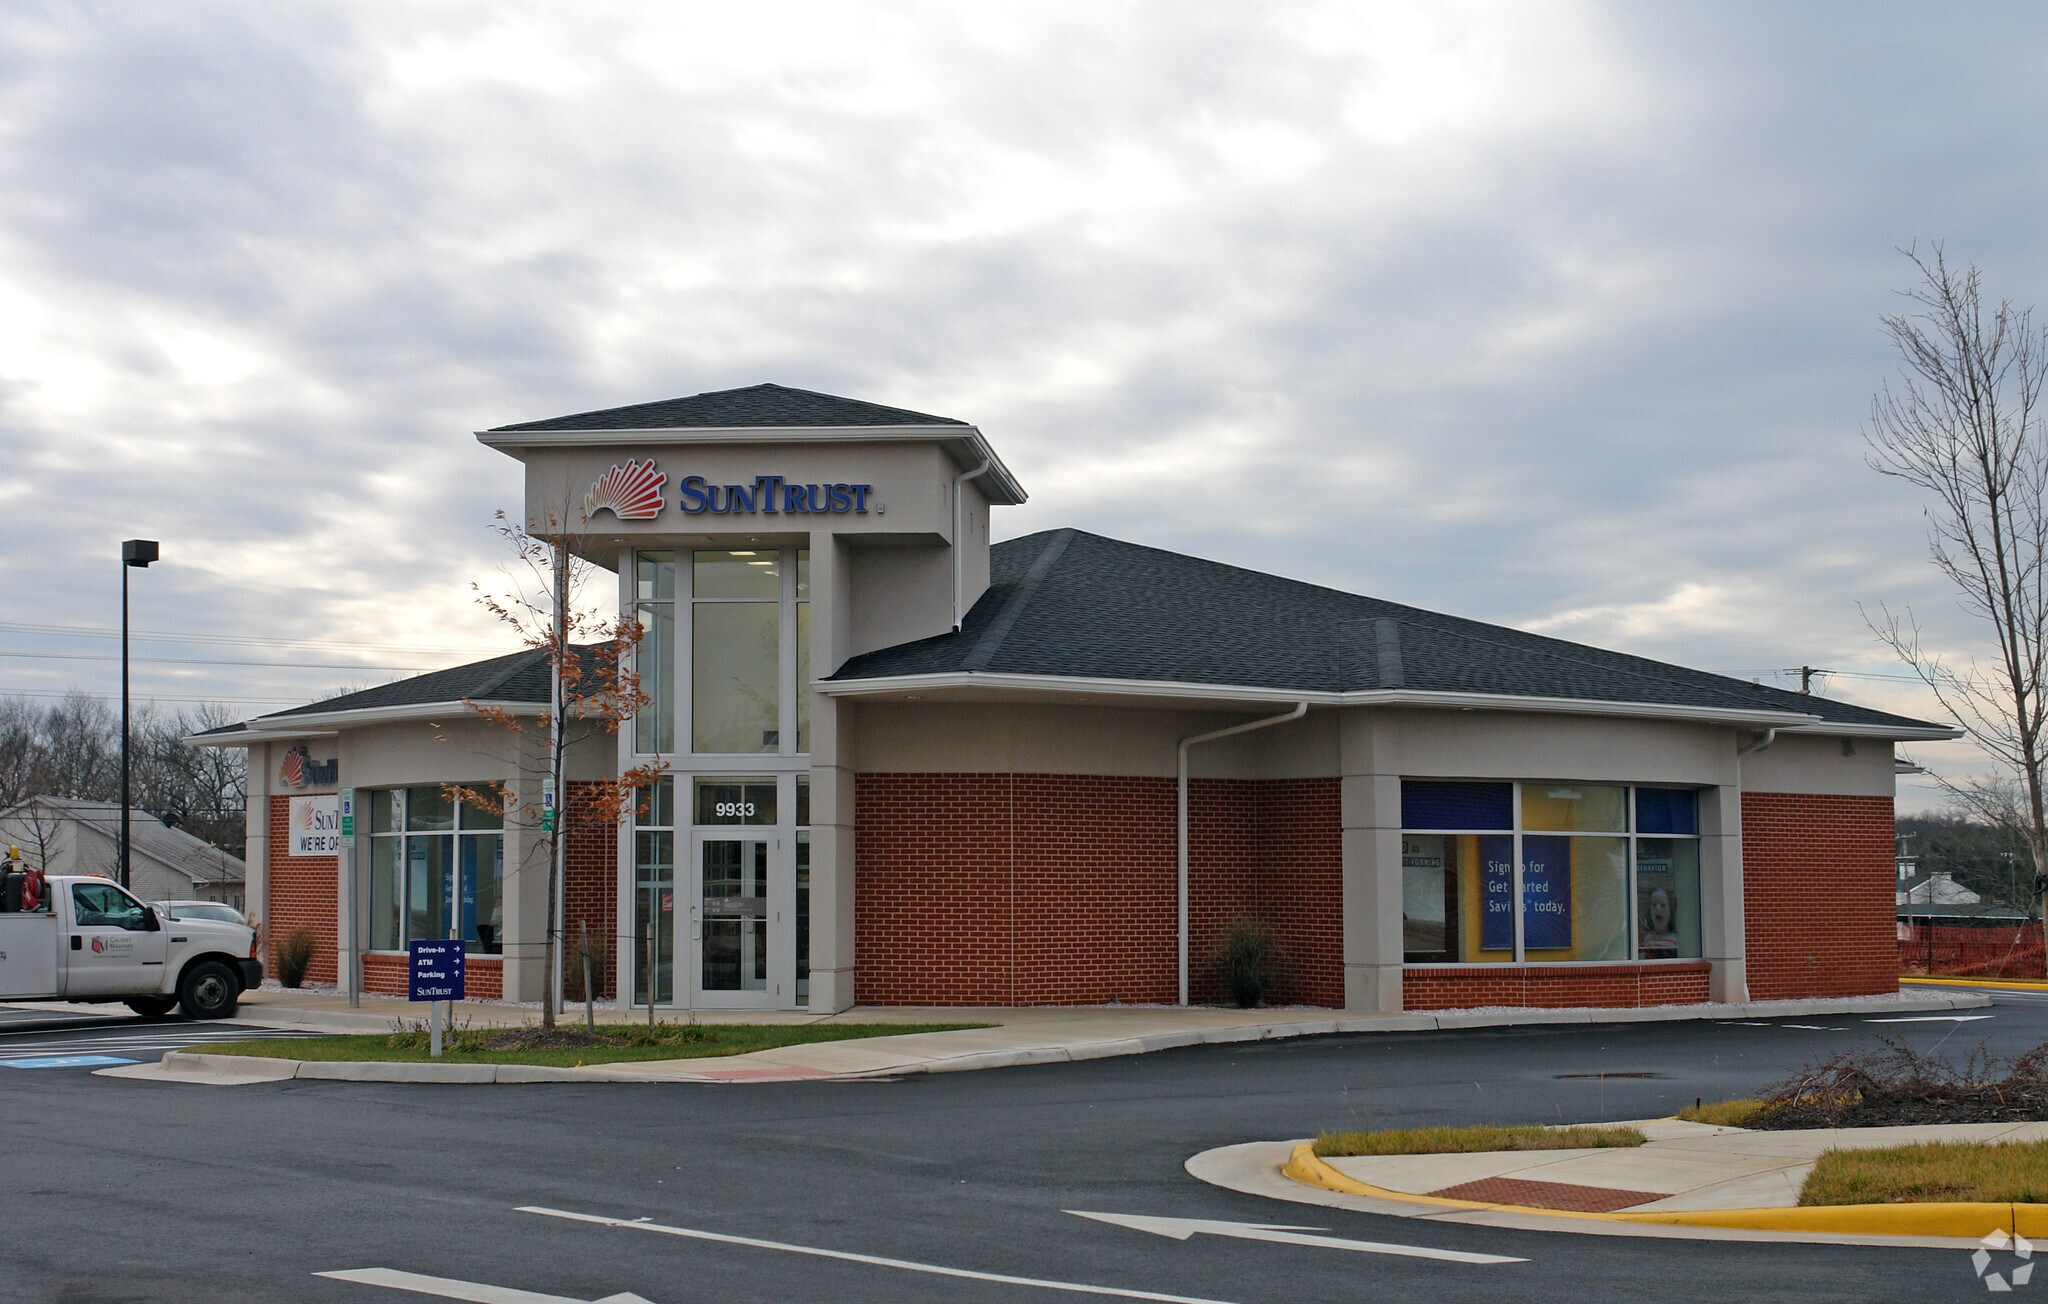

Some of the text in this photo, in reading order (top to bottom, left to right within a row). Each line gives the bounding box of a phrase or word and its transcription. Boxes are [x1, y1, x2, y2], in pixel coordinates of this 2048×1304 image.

[715, 802, 755, 817] 9933
[300, 836, 325, 851] WE'RE
[1488, 861, 1511, 875] Sign
[1529, 861, 1545, 873] for
[1488, 881, 1508, 893] Get
[1534, 900, 1566, 915] today.
[417, 971, 446, 979] Parking
